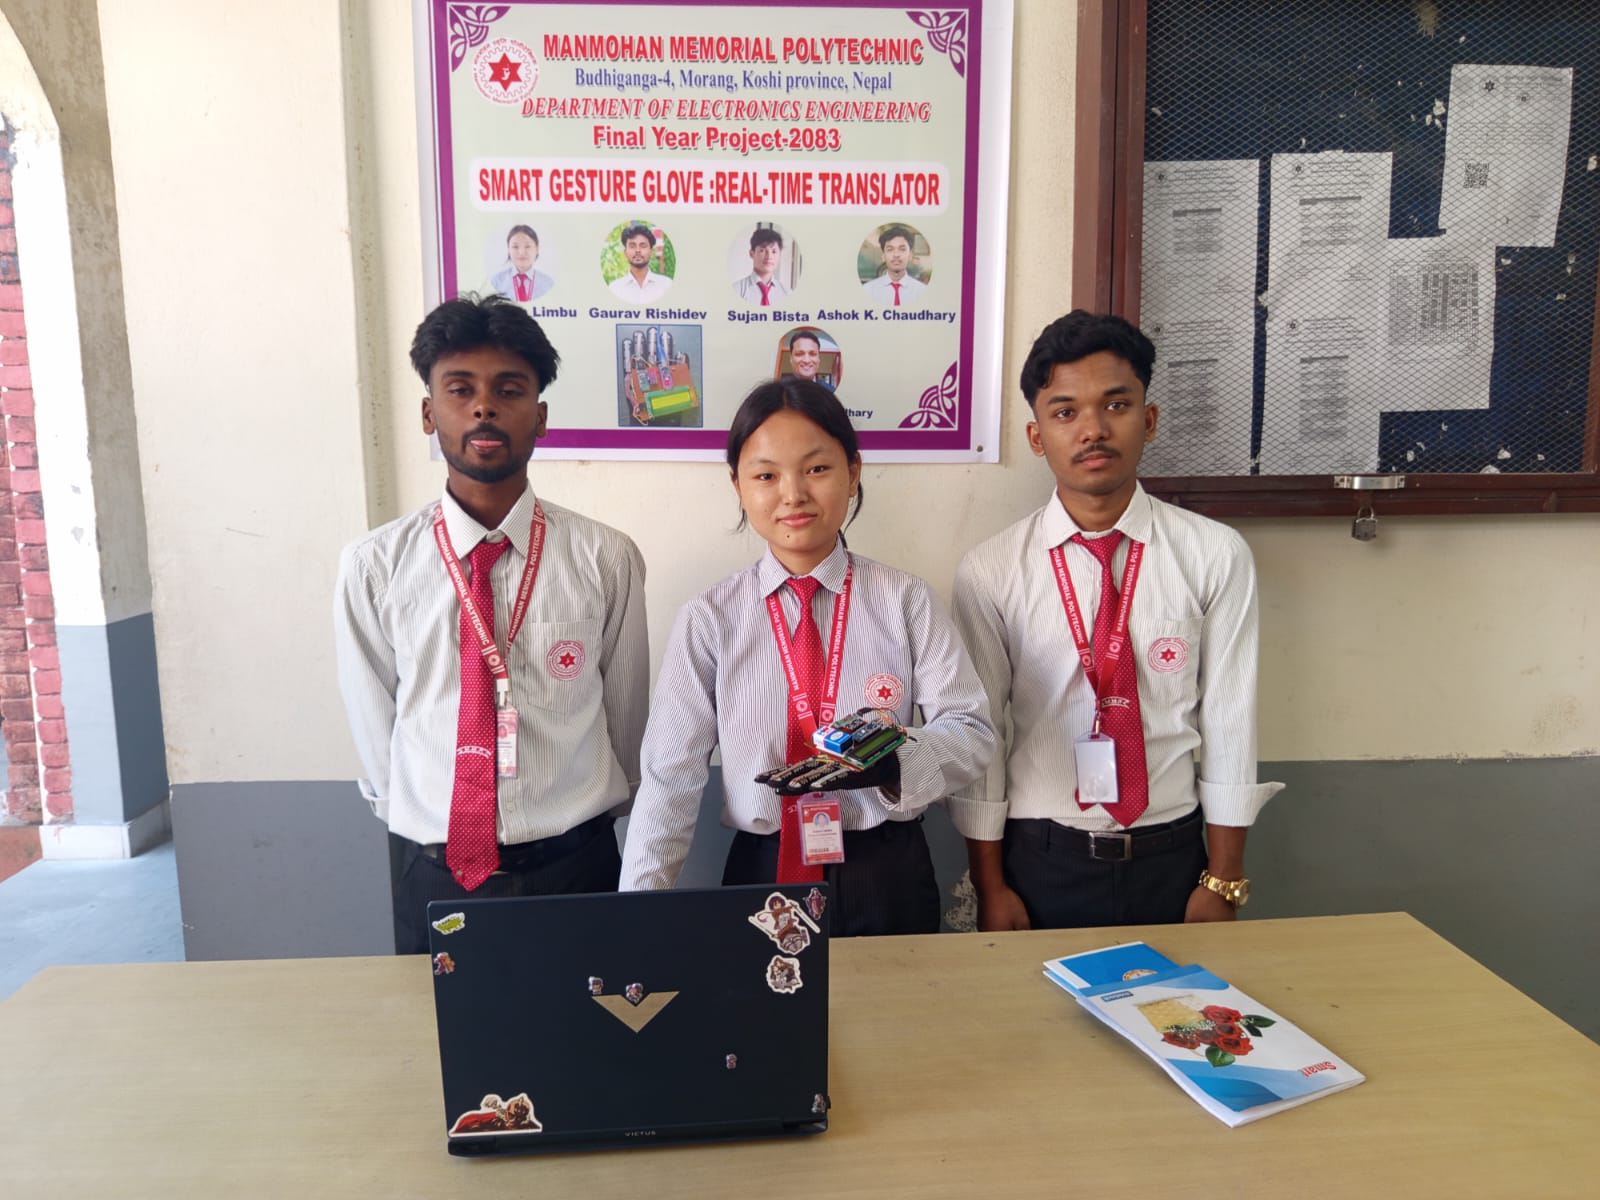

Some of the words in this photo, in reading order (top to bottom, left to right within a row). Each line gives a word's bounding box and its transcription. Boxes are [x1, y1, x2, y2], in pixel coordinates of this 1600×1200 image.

[543, 34, 663, 62] MANMOHAN
[669, 36, 776, 63] MEMORIAL
[782, 37, 924, 65] POLYTECHNIC
[575, 68, 676, 91] Budhiganga-4,
[679, 69, 738, 92] Morang,
[742, 70, 782, 90] Koshi
[785, 71, 849, 94] province,
[852, 72, 893, 94] Nepal
[521, 97, 642, 119] DEPARTMENT
[646, 99, 674, 118] OF
[676, 99, 802, 121] ELECTRONICS
[805, 101, 931, 122] ENGINEERING
[593, 126, 645, 149] Final
[651, 126, 700, 149] Year
[706, 127, 841, 154] Project-2083
[479, 168, 543, 202] SMART
[549, 169, 637, 203] GESTURE
[642, 170, 704, 204] GLOVE
[818, 172, 940, 207] TRANSLATOR
[532, 306, 577, 319] Limbu
[589, 307, 642, 320] Gaurav
[646, 307, 707, 321] Rishidev
[727, 310, 770, 324] Sujan
[772, 310, 810, 322] Bista
[817, 309, 860, 321] Ashok
[864, 309, 879, 321] K.
[883, 309, 956, 323] Chaudhary
[437, 524, 454, 562] MANMOHAN
[449, 562, 468, 598] MEMORIAL
[464, 598, 490, 646] POLYTECHNIC
[509, 600, 525, 639] MANMOHAN
[520, 566, 535, 600] MEMORIAL
[529, 523, 542, 566] POLYTECHNIC
[1053, 547, 1063, 569] OHAN
[1058, 568, 1072, 600] MEMORIAL
[1067, 600, 1085, 644] POLYTECHNIC
[768, 593, 780, 623] POLYTEC
[1117, 595, 1129, 632] MANMOHAN
[1123, 564, 1136, 596] MEMORIAL
[776, 623, 789, 654] MEMORIAL
[832, 620, 843, 653] MEMORIAL
[784, 654, 799, 690] MANMOHAN
[826, 653, 839, 698] POLYTECHNIC
